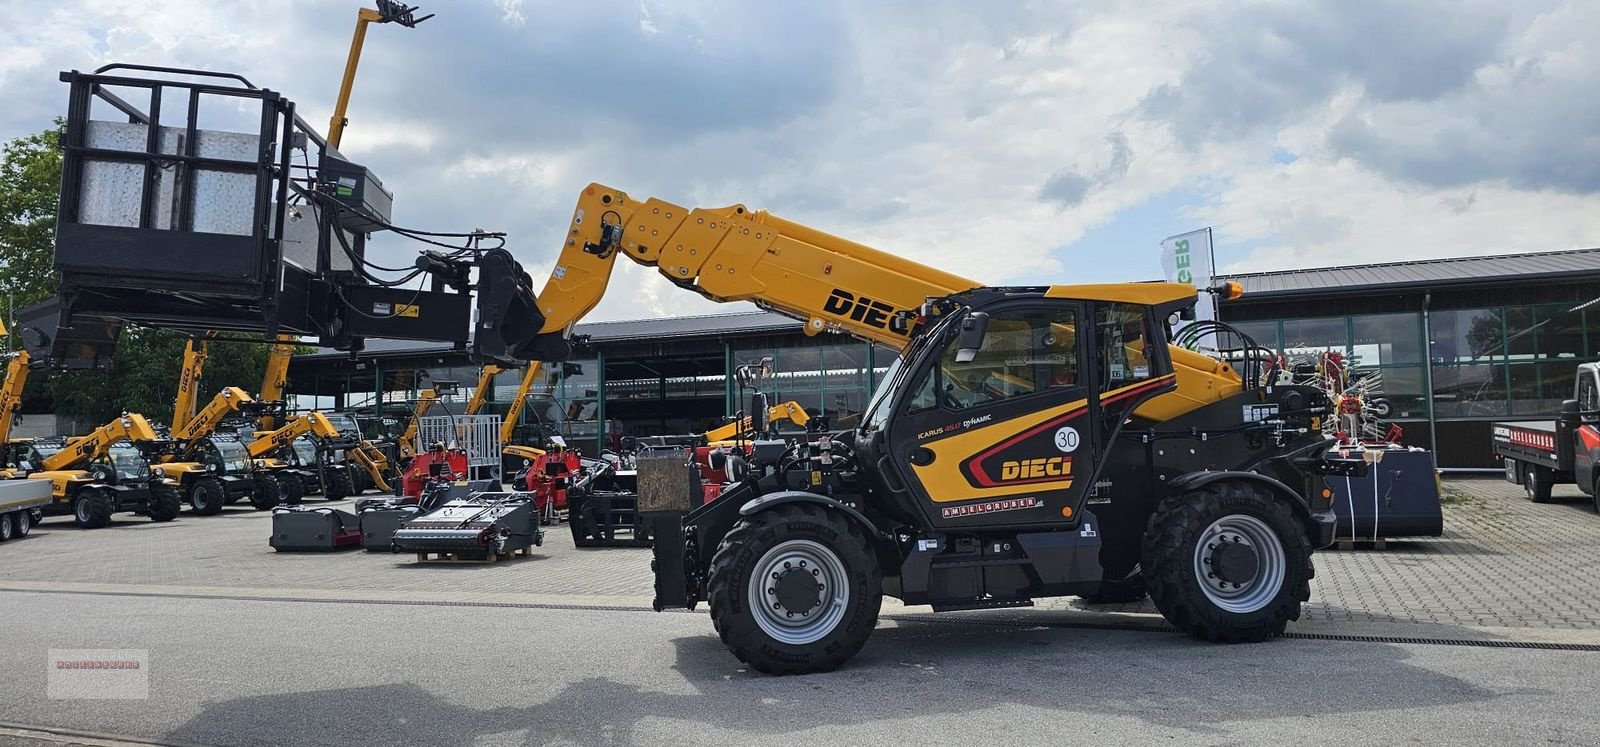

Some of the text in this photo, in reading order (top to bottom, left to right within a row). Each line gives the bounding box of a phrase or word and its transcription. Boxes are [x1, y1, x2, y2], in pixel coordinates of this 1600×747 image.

[917, 427, 944, 439] ICARUS
[1057, 431, 1078, 448] 30
[1001, 456, 1073, 481] DIECI
[943, 498, 1035, 518] AMSELGRUBER
